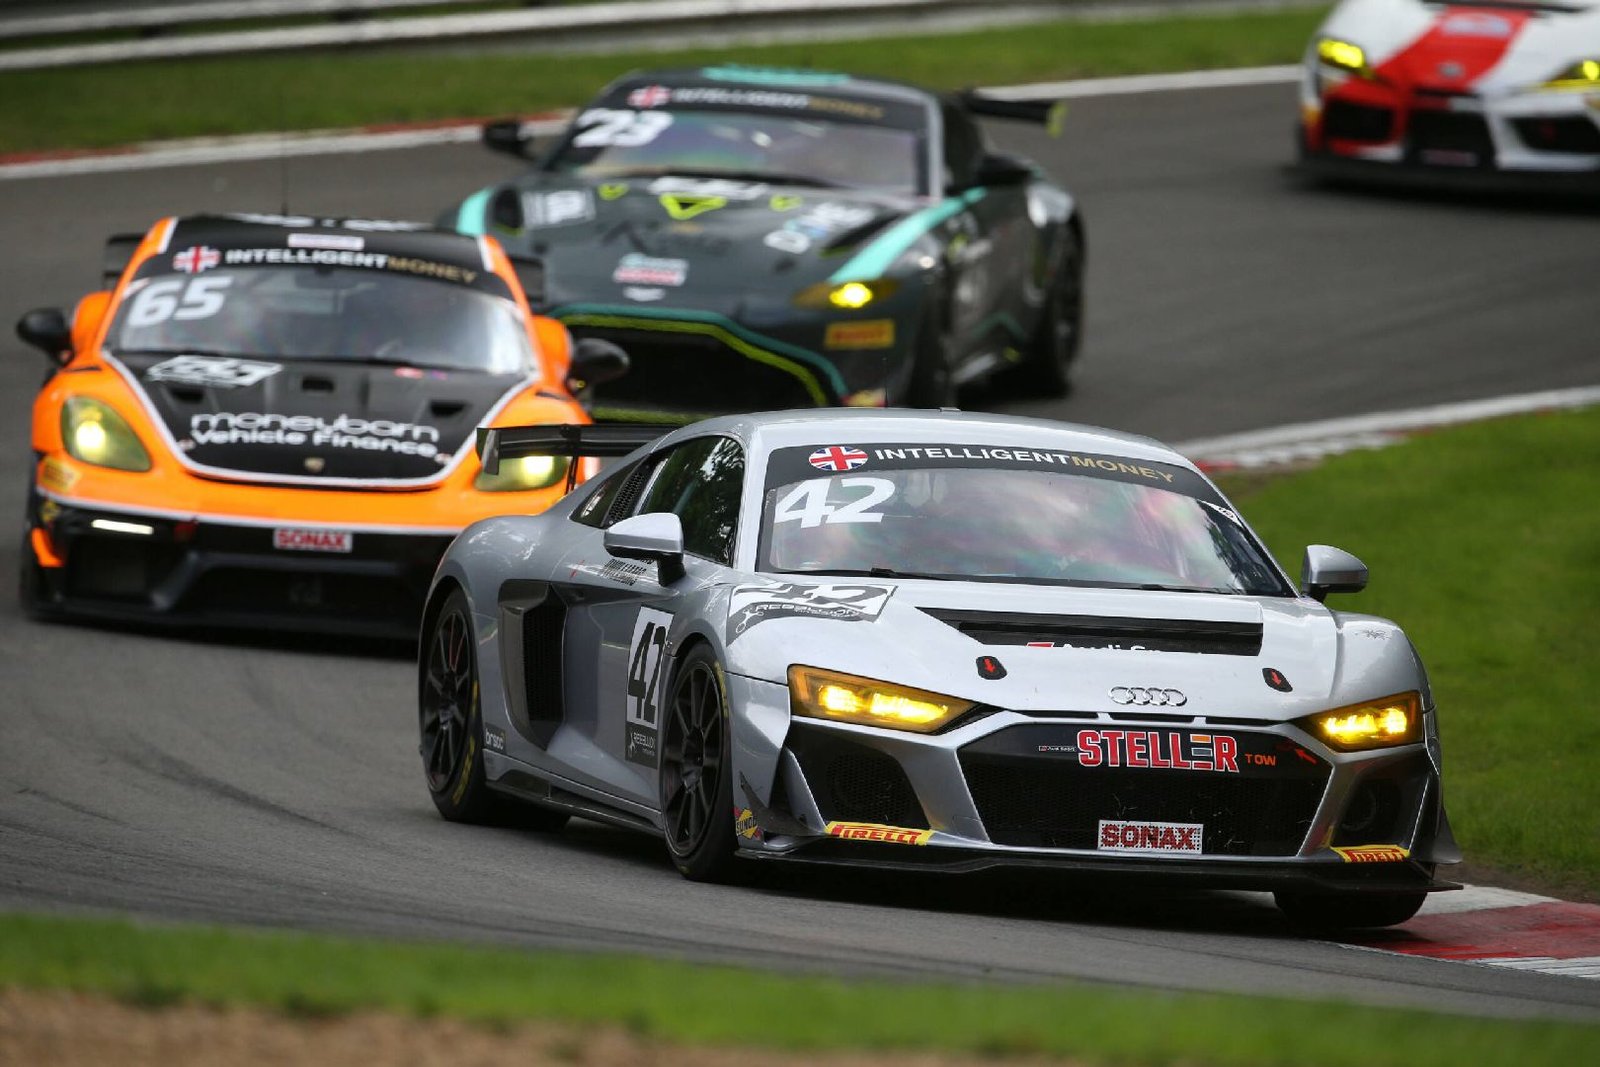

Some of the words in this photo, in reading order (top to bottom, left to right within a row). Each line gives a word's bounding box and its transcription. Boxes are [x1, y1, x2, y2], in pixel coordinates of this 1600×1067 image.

[572, 107, 675, 148] 23
[127, 275, 235, 328] 65
[191, 413, 440, 442] moneybarn
[192, 429, 307, 445] Vehicle
[312, 432, 438, 458] Finance
[774, 476, 896, 529] 42
[276, 529, 347, 549] SONAX
[627, 621, 666, 725] 42
[1077, 729, 1240, 773] STELLER
[1244, 753, 1277, 766] TOW
[829, 824, 923, 845] PIRELLI
[1100, 824, 1198, 850] SONAX
[1341, 847, 1405, 863] PIRELLI
